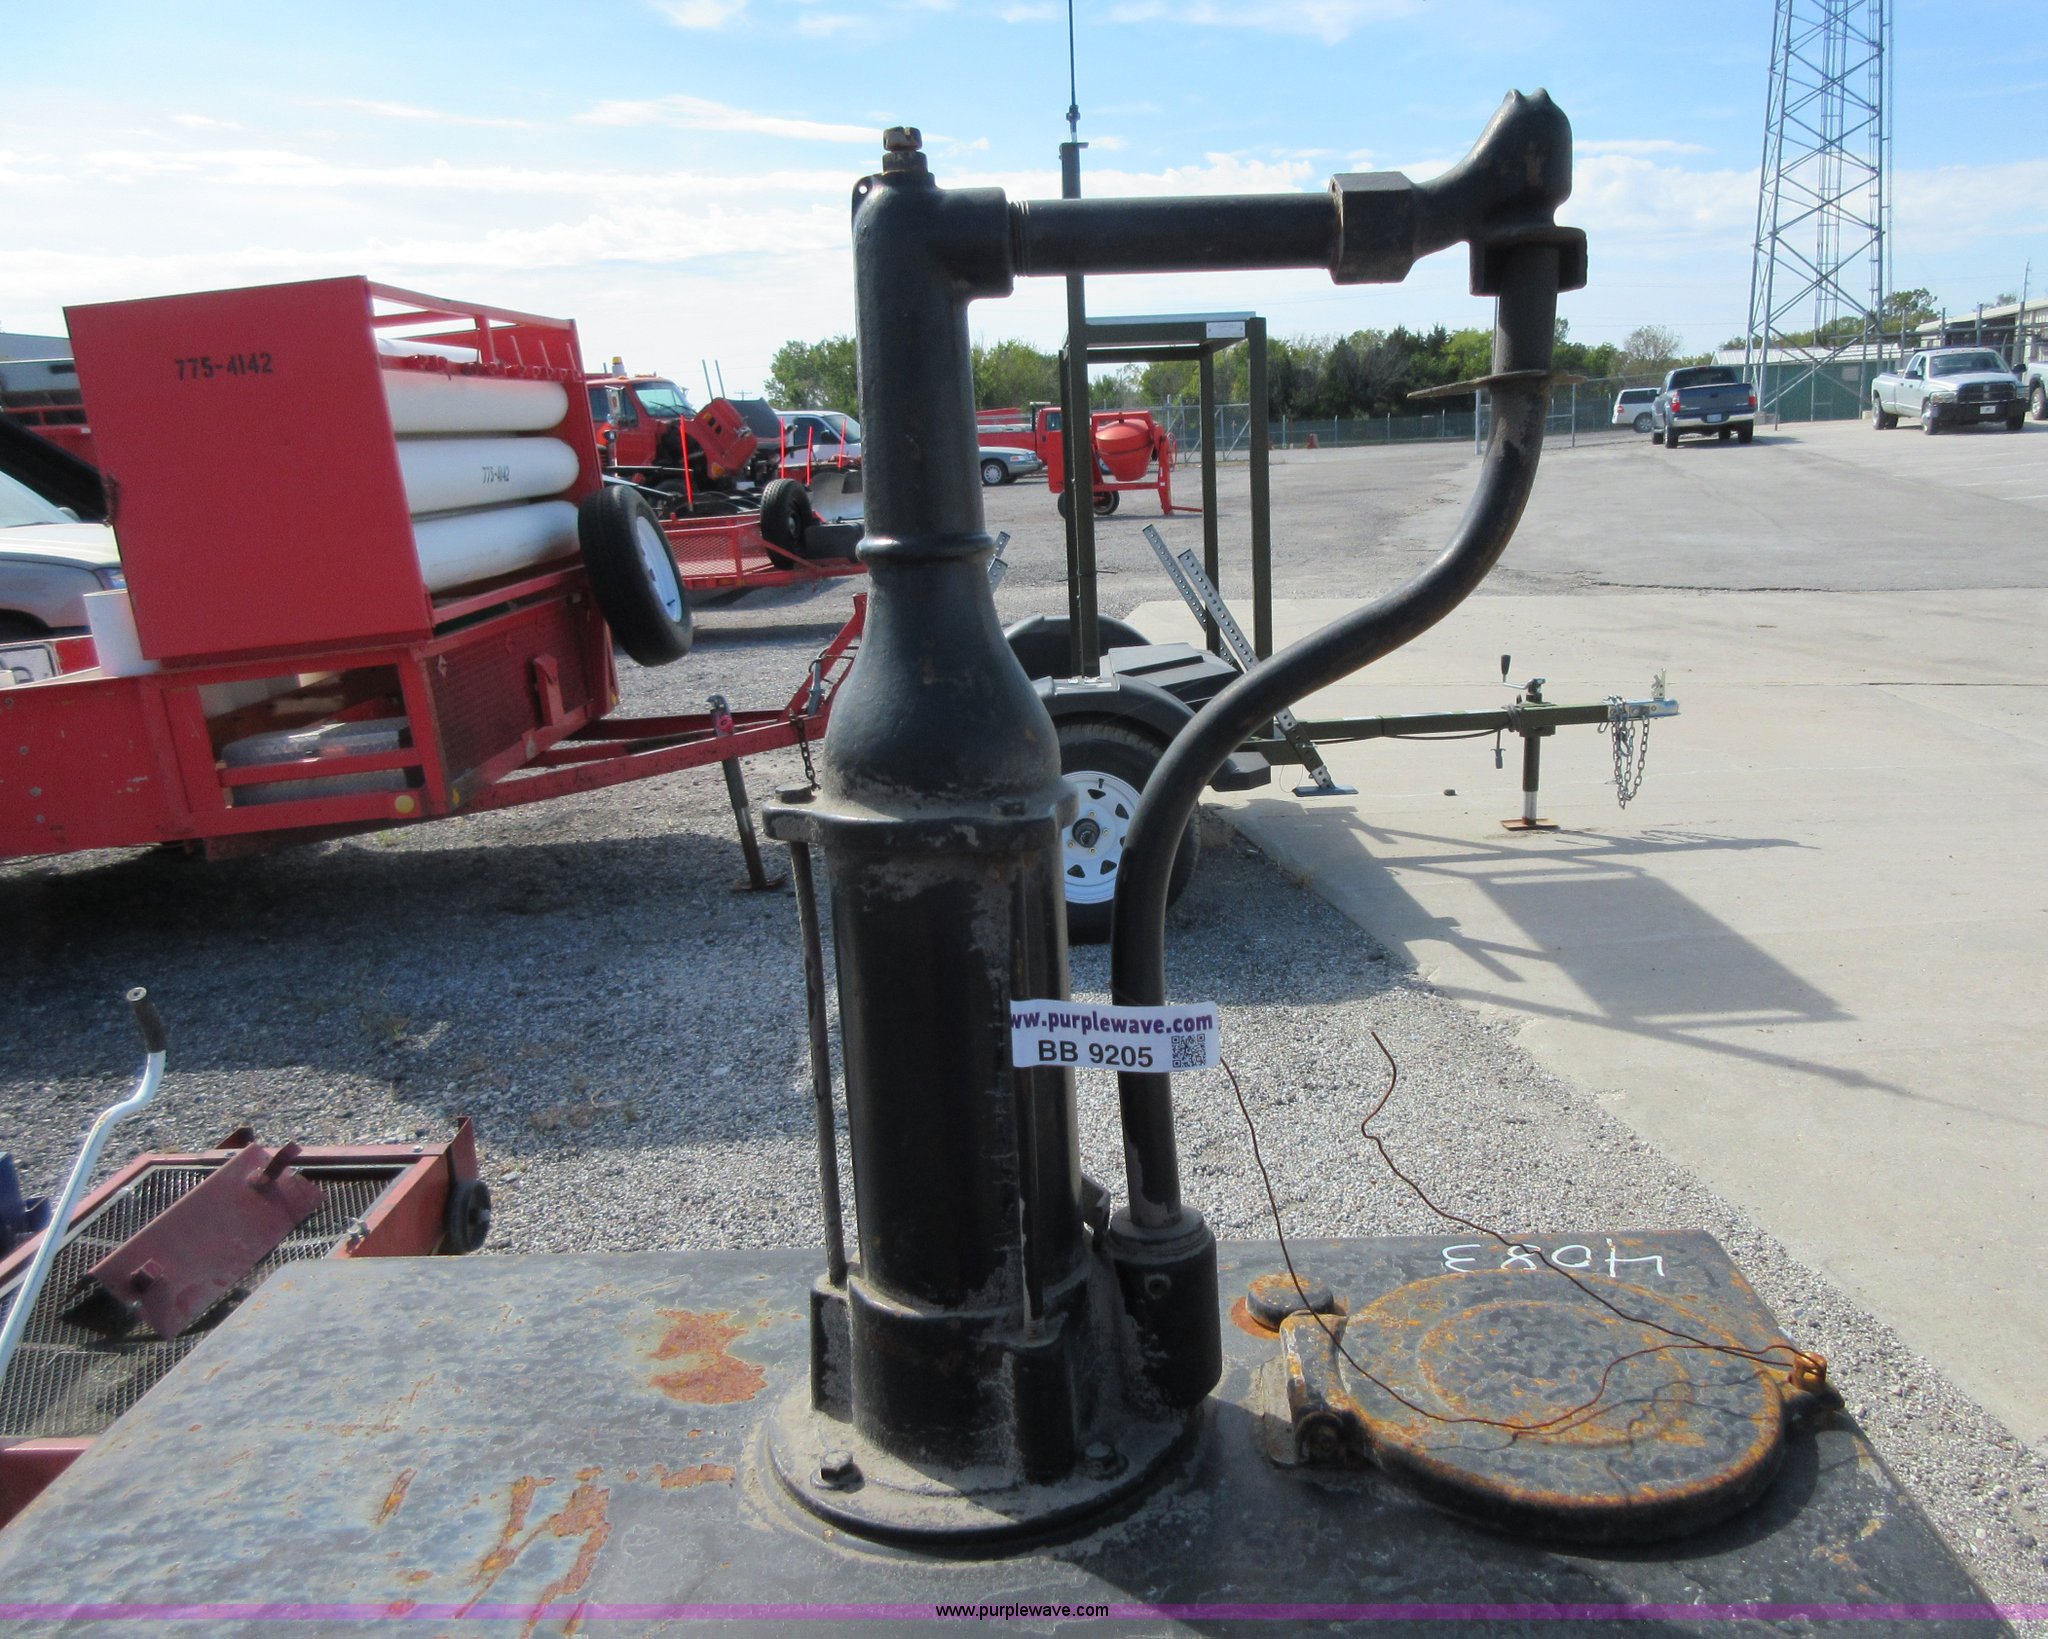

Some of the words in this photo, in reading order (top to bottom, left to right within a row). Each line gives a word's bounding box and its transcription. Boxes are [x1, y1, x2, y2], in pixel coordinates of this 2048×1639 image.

[175, 351, 273, 381] 775-4142
[1037, 1039, 1078, 1062] BB
[1088, 1043, 1153, 1068] 9205
